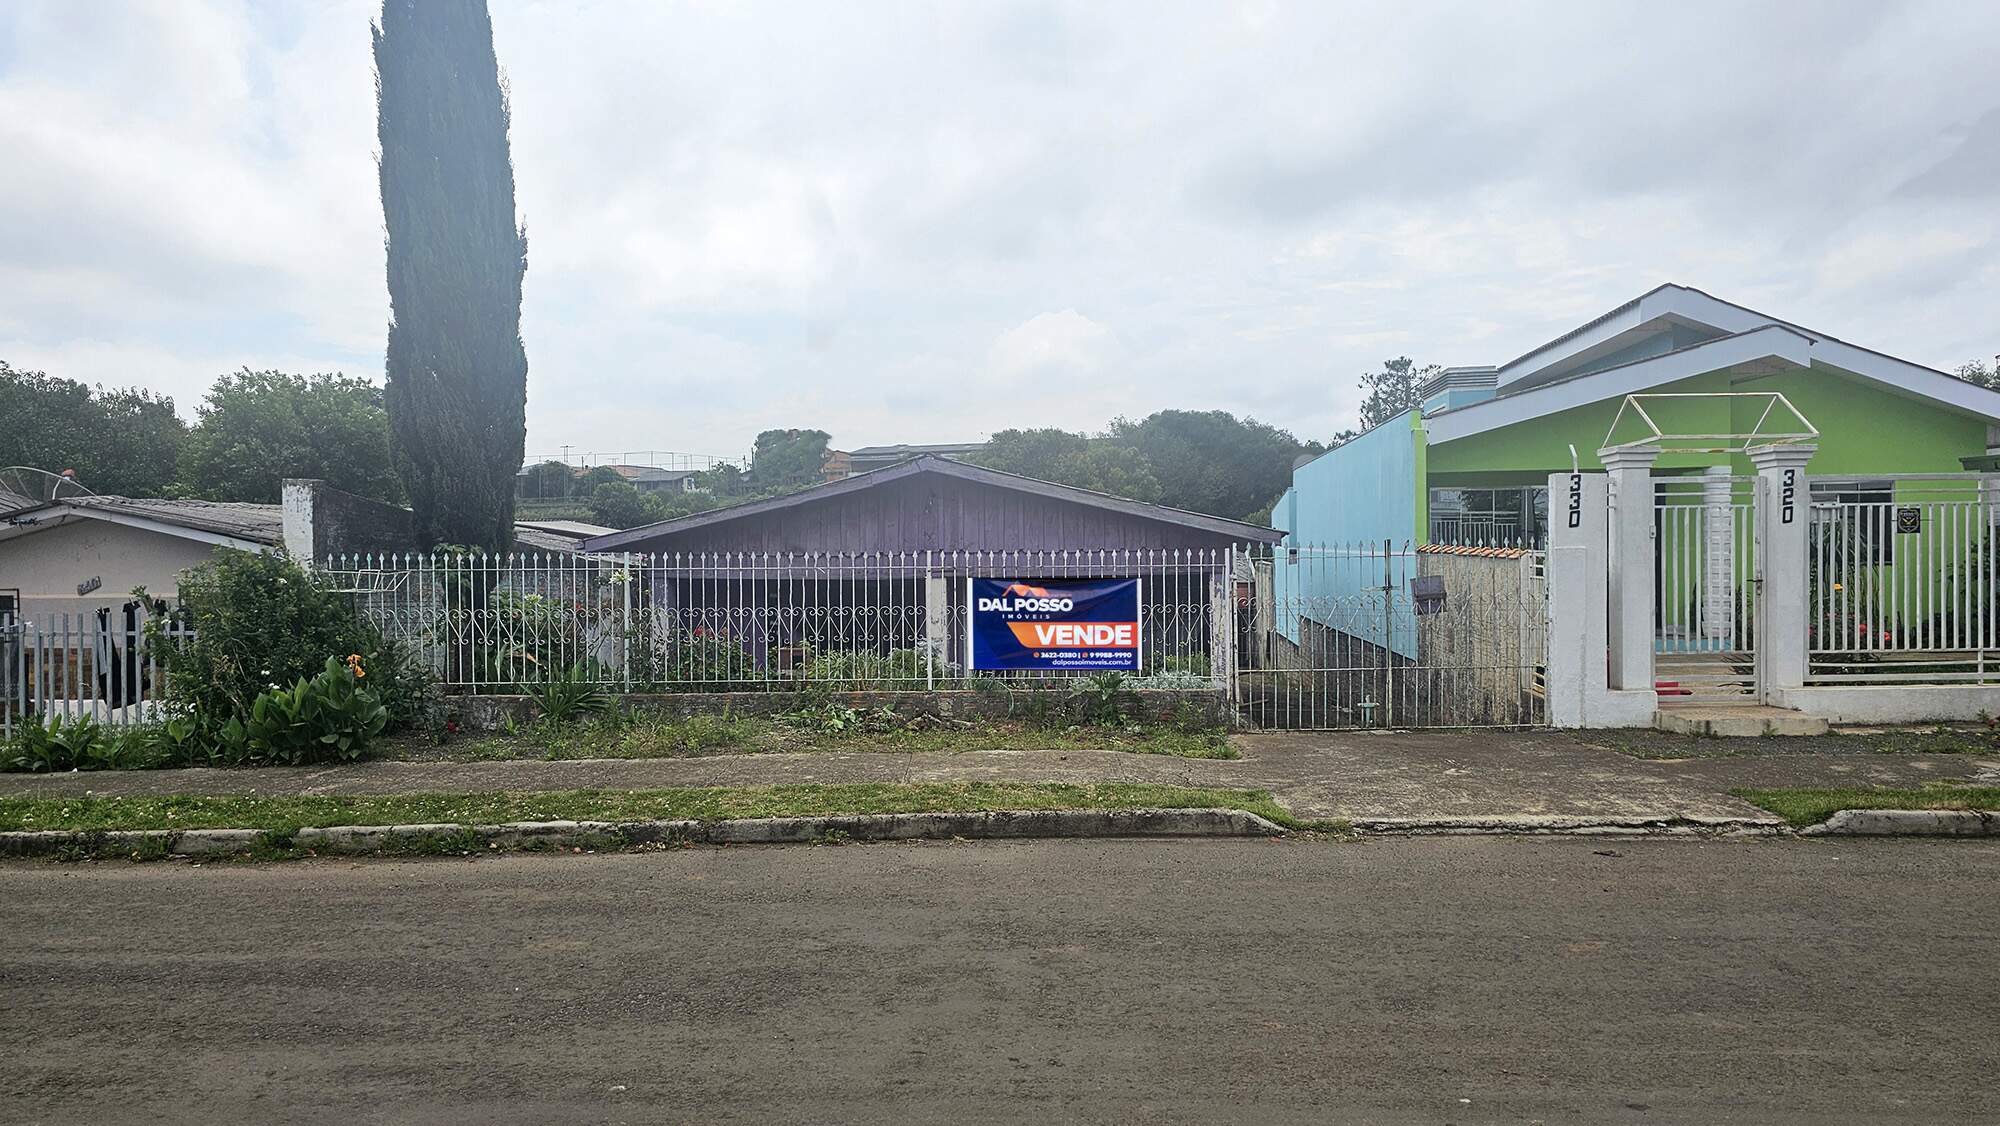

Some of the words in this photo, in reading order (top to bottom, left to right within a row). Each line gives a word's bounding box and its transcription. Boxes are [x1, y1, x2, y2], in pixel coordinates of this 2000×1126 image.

[1568, 474, 1581, 528] 330
[1782, 469, 1795, 524] 320
[979, 598, 1013, 611] DAL
[1015, 598, 1073, 611] POSSO
[1034, 625, 1132, 645] VENDE
